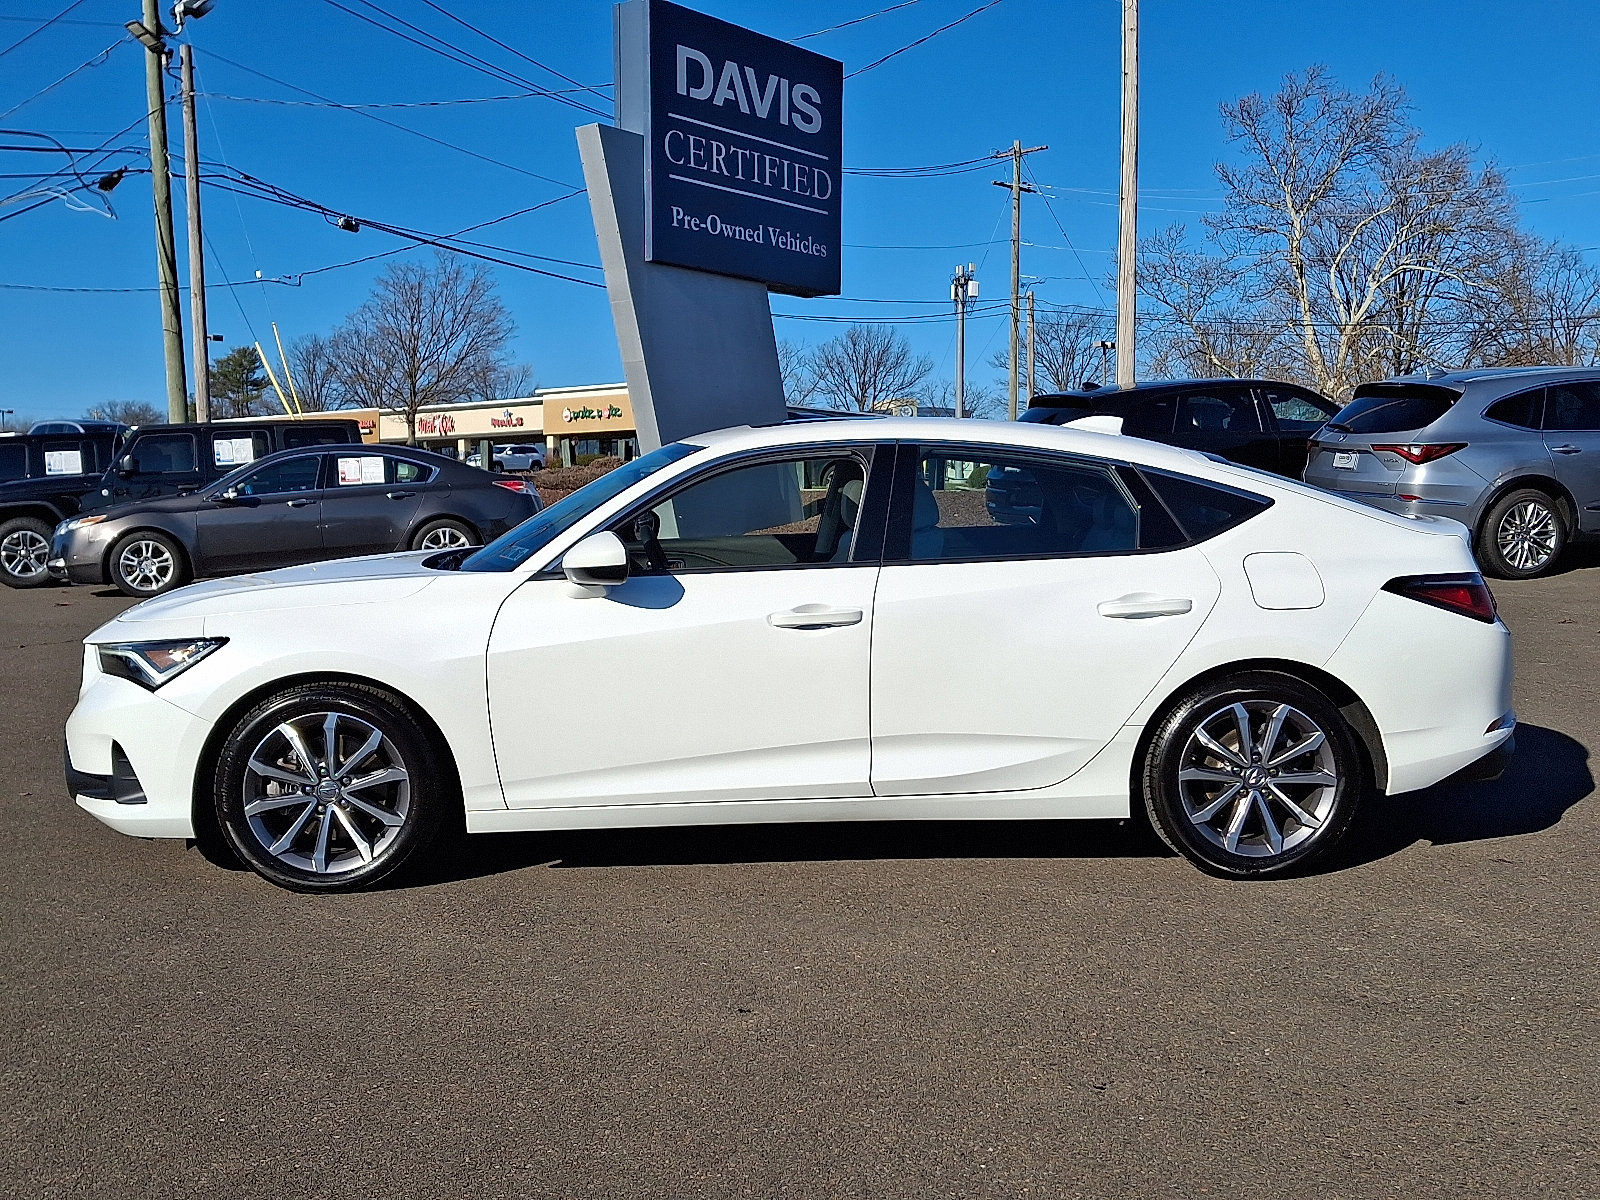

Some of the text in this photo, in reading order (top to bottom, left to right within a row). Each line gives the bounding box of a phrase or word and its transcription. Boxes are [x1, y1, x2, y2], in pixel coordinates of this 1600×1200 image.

[676, 43, 822, 134] DAVIS
[664, 129, 832, 200] CERTIFIED
[671, 205, 827, 258] Pre-Owned Vehicles
